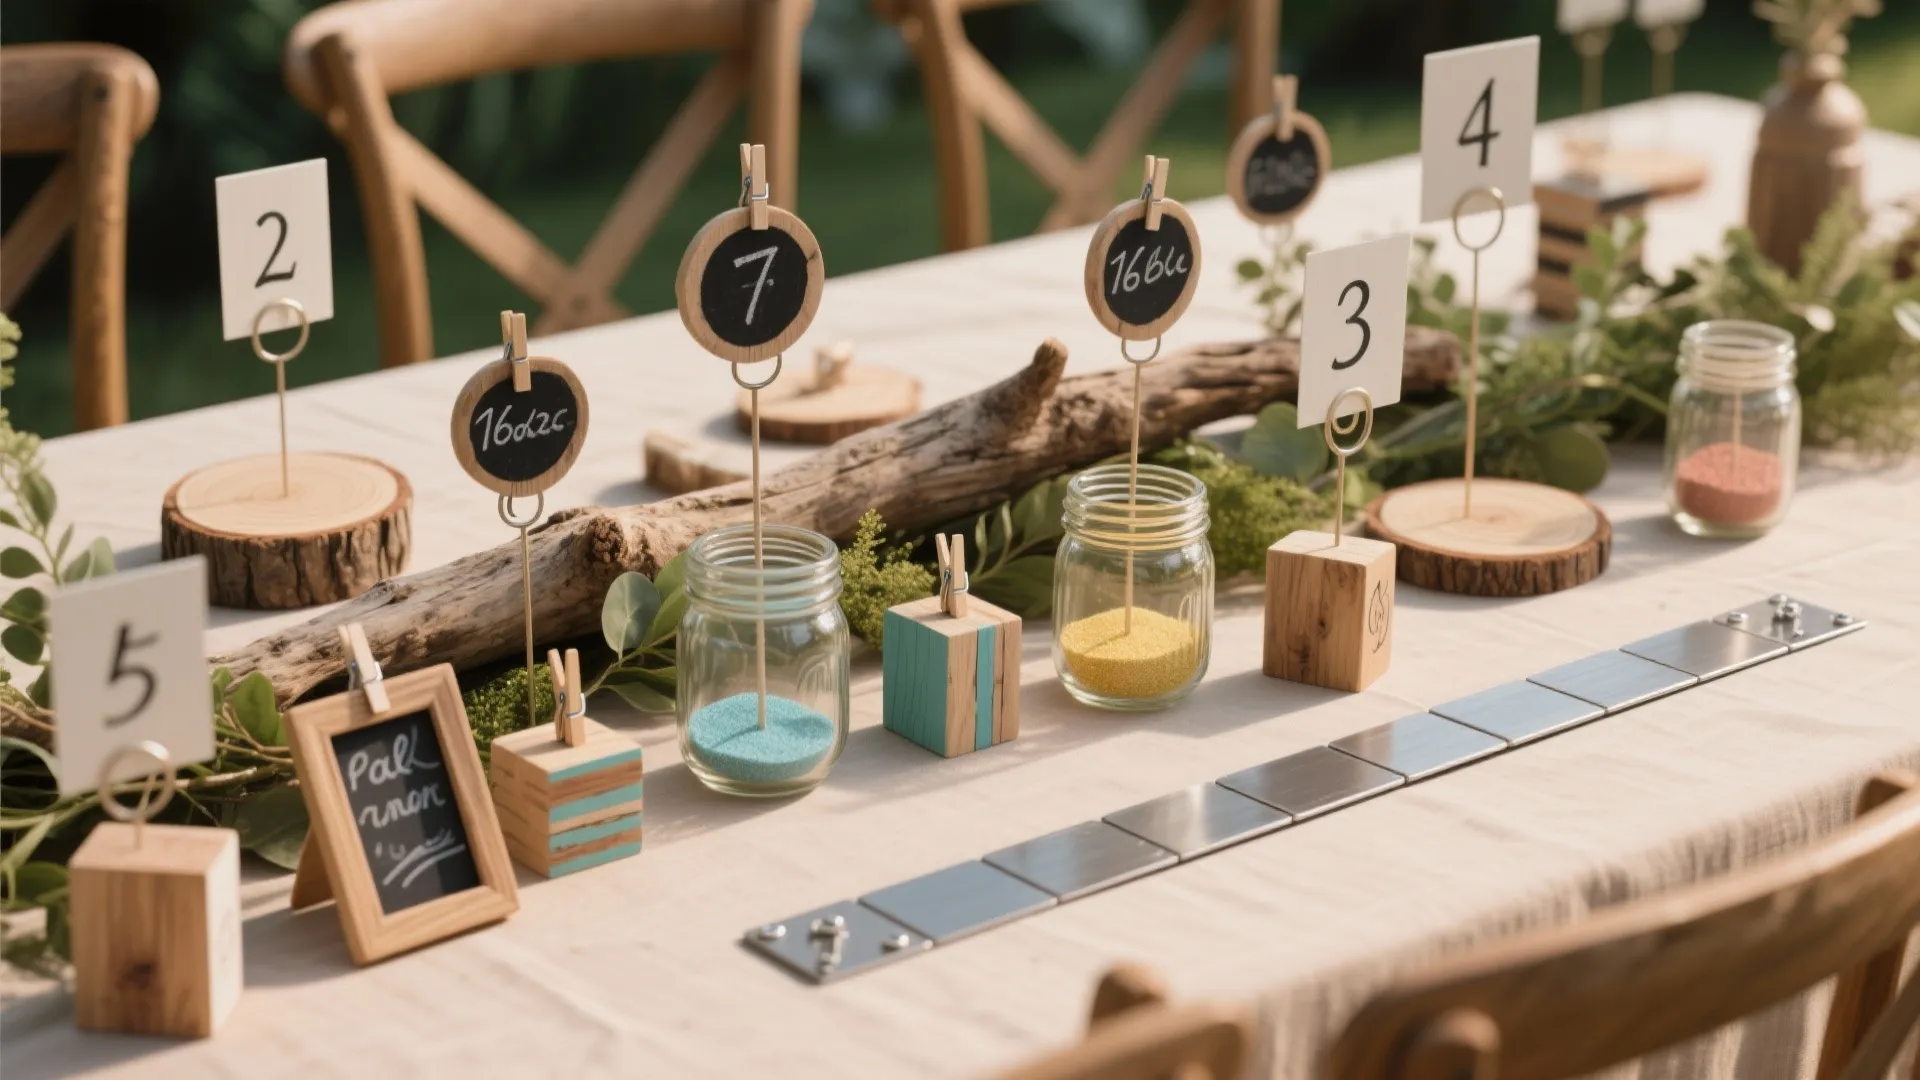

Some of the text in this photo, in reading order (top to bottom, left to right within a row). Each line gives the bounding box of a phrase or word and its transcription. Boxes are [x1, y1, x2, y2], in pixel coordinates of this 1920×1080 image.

[1458, 77, 1500, 168] 4
[255, 211, 297, 288] 2
[733, 246, 778, 325] 7
[1331, 279, 1371, 370] 3
[104, 621, 159, 730] 5
